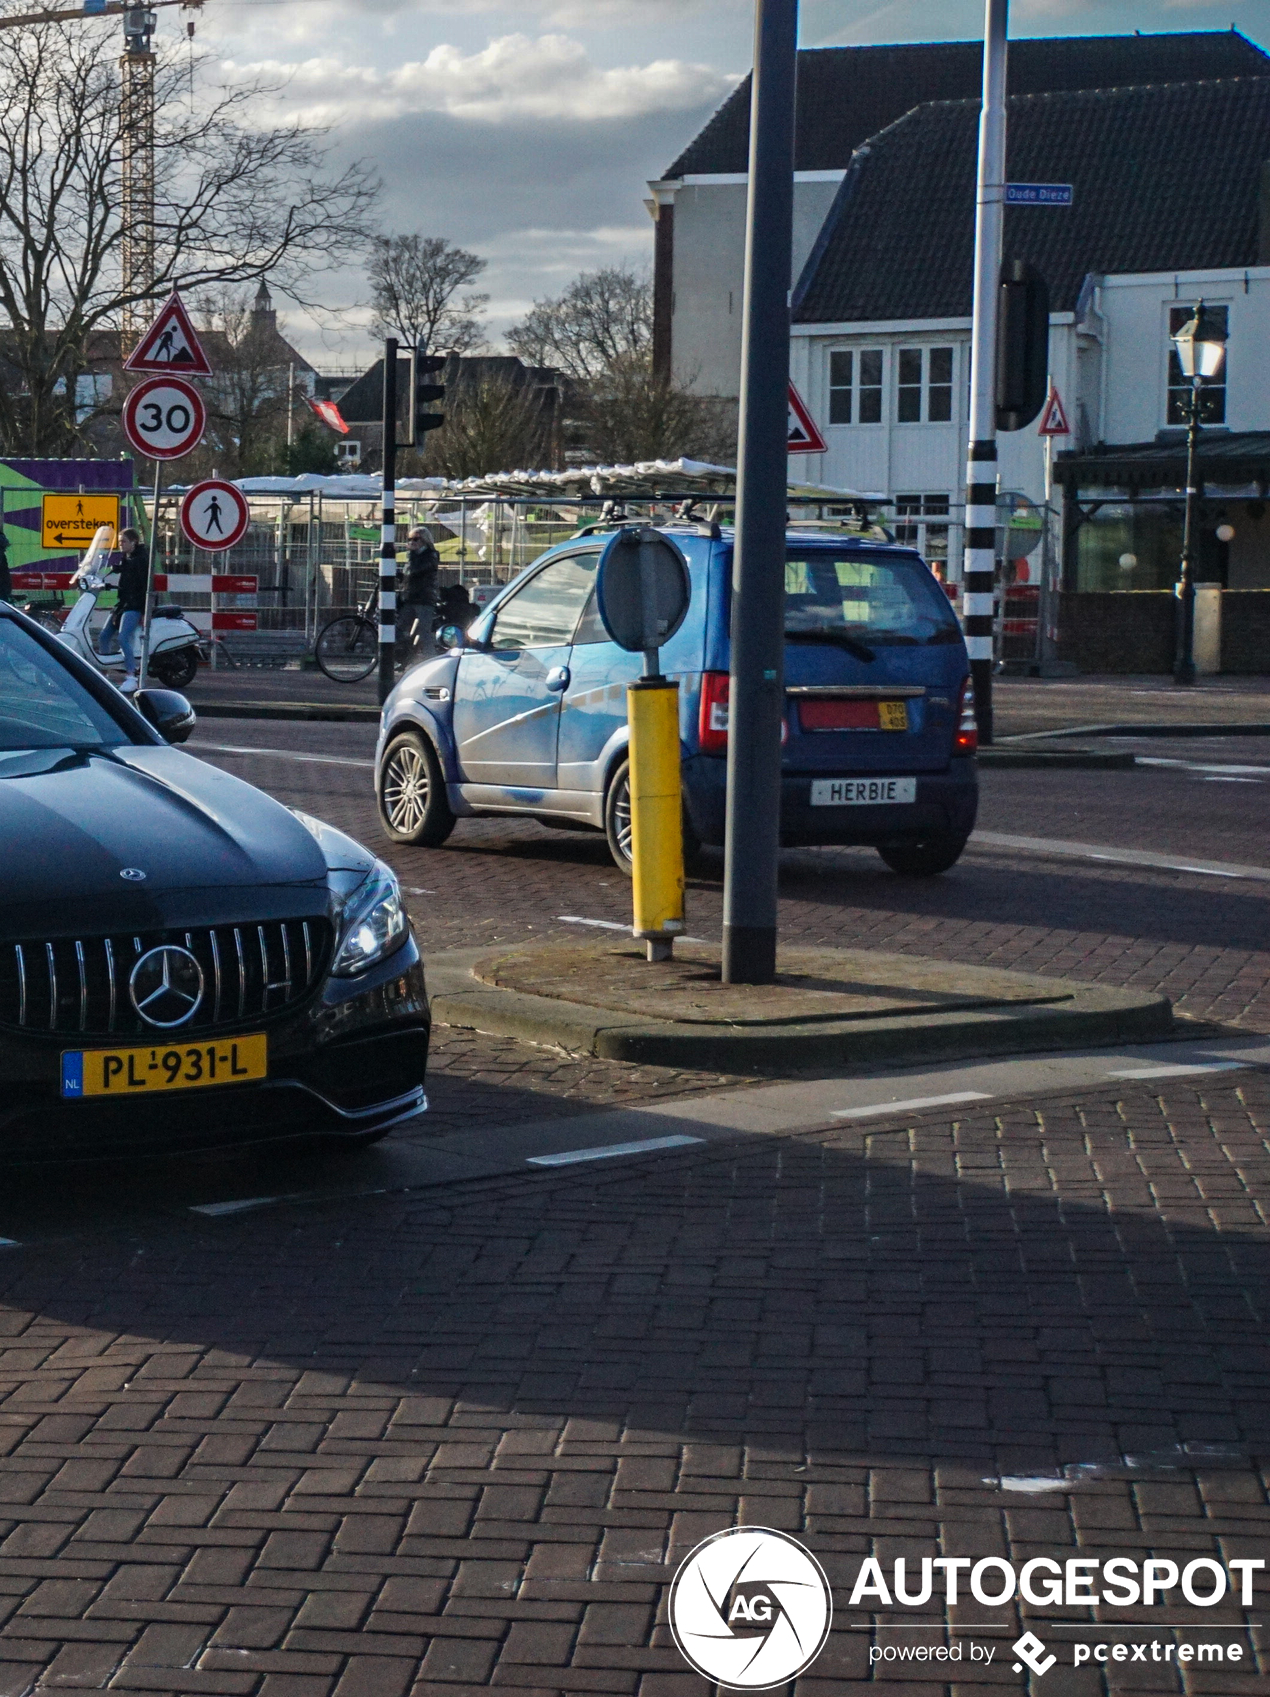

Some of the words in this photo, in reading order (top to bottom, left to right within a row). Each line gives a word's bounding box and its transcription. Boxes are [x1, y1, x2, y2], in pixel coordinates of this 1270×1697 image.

[1008, 188, 1036, 199] Oude
[1039, 189, 1070, 200] Dieze
[139, 403, 190, 434] 30
[831, 782, 896, 801] HERBIE
[65, 1079, 80, 1090] NL
